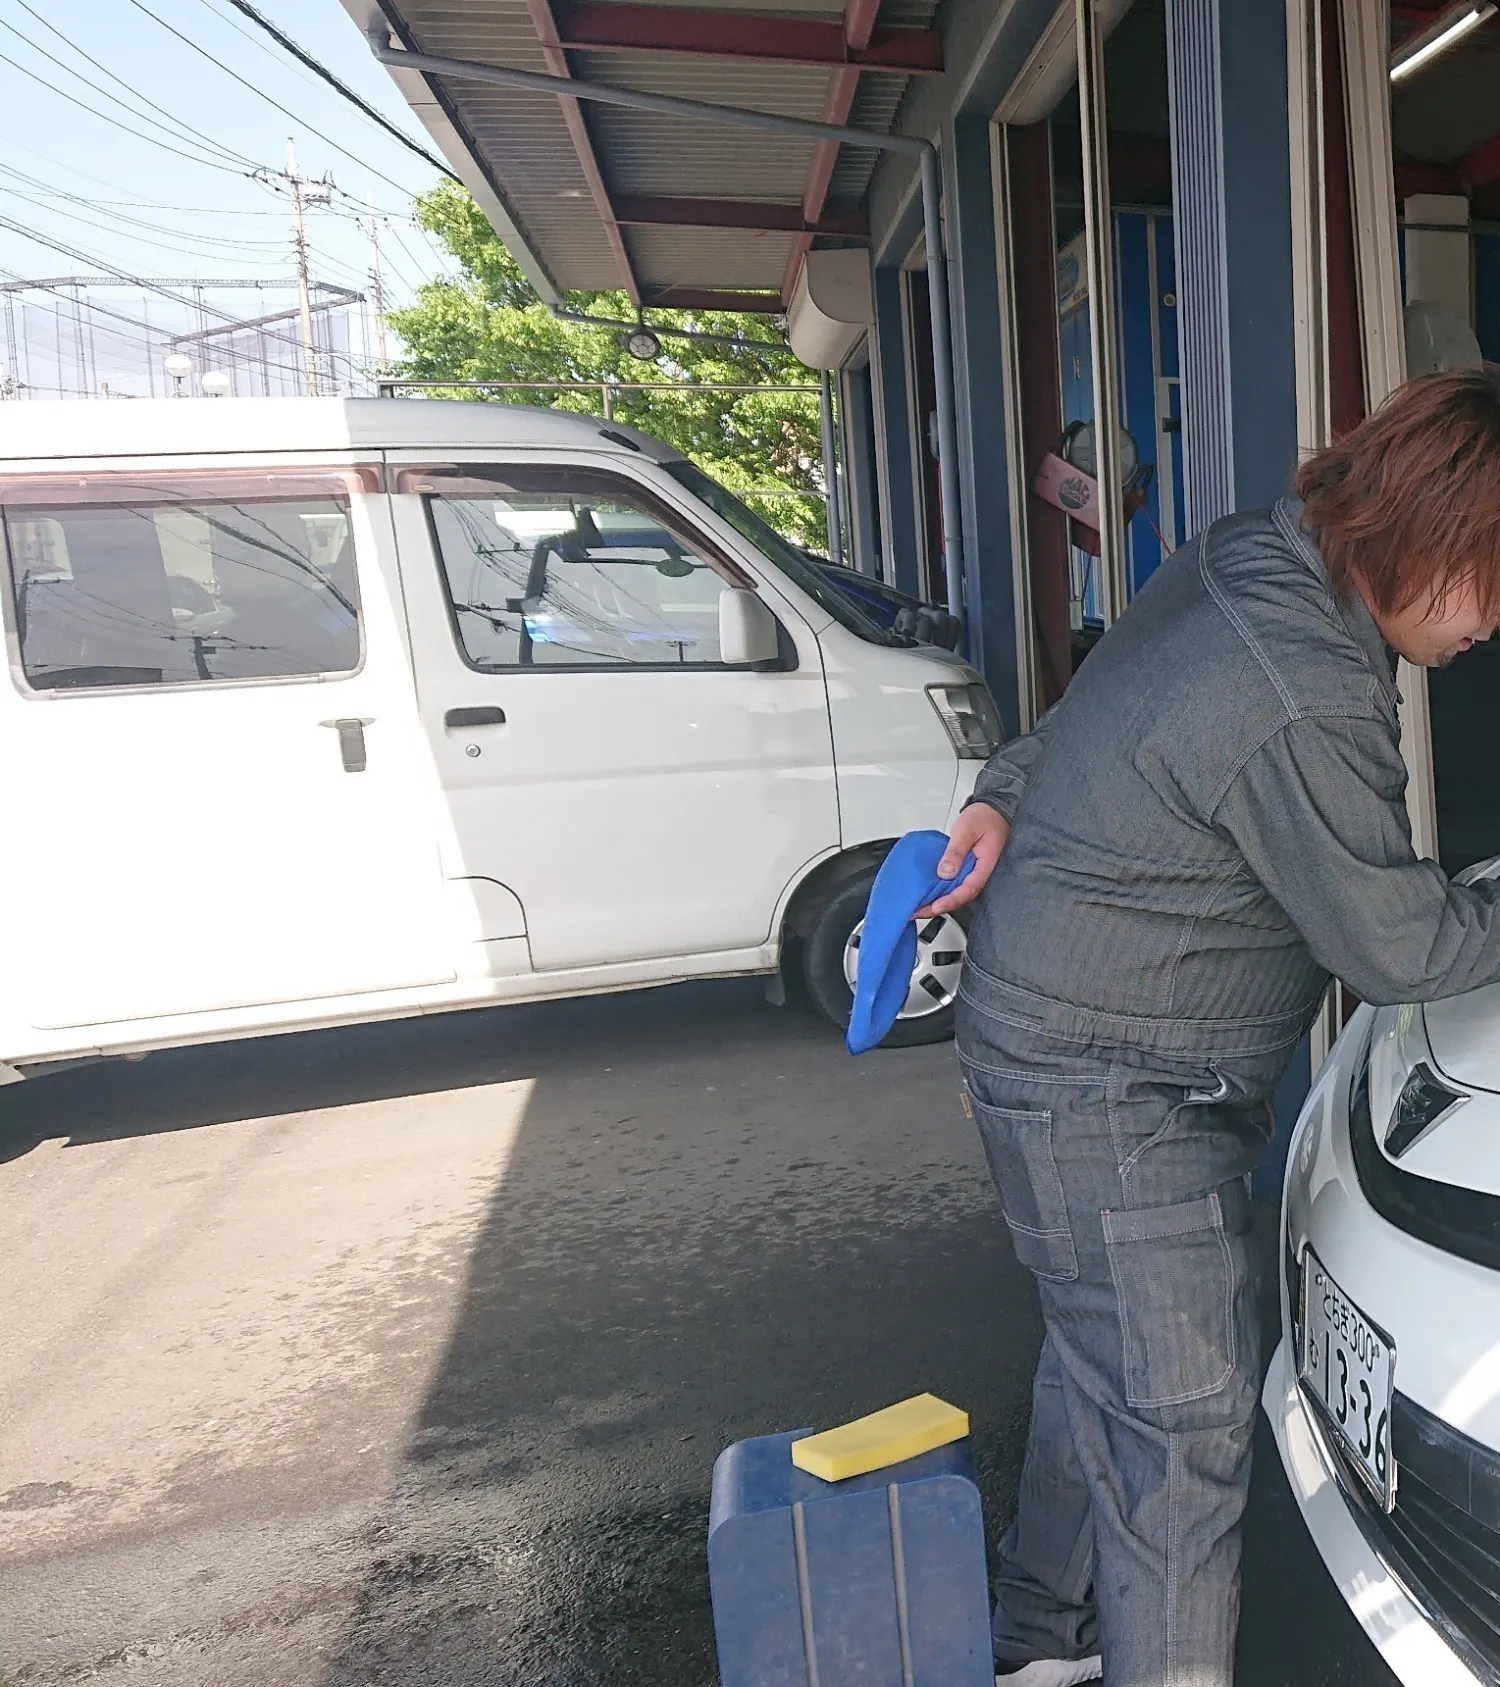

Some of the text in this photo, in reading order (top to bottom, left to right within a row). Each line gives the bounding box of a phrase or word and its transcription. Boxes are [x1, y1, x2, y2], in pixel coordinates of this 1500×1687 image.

[1323, 1279, 1374, 1373] とちぎ 300
[1325, 1330, 1387, 1483] 13-36
